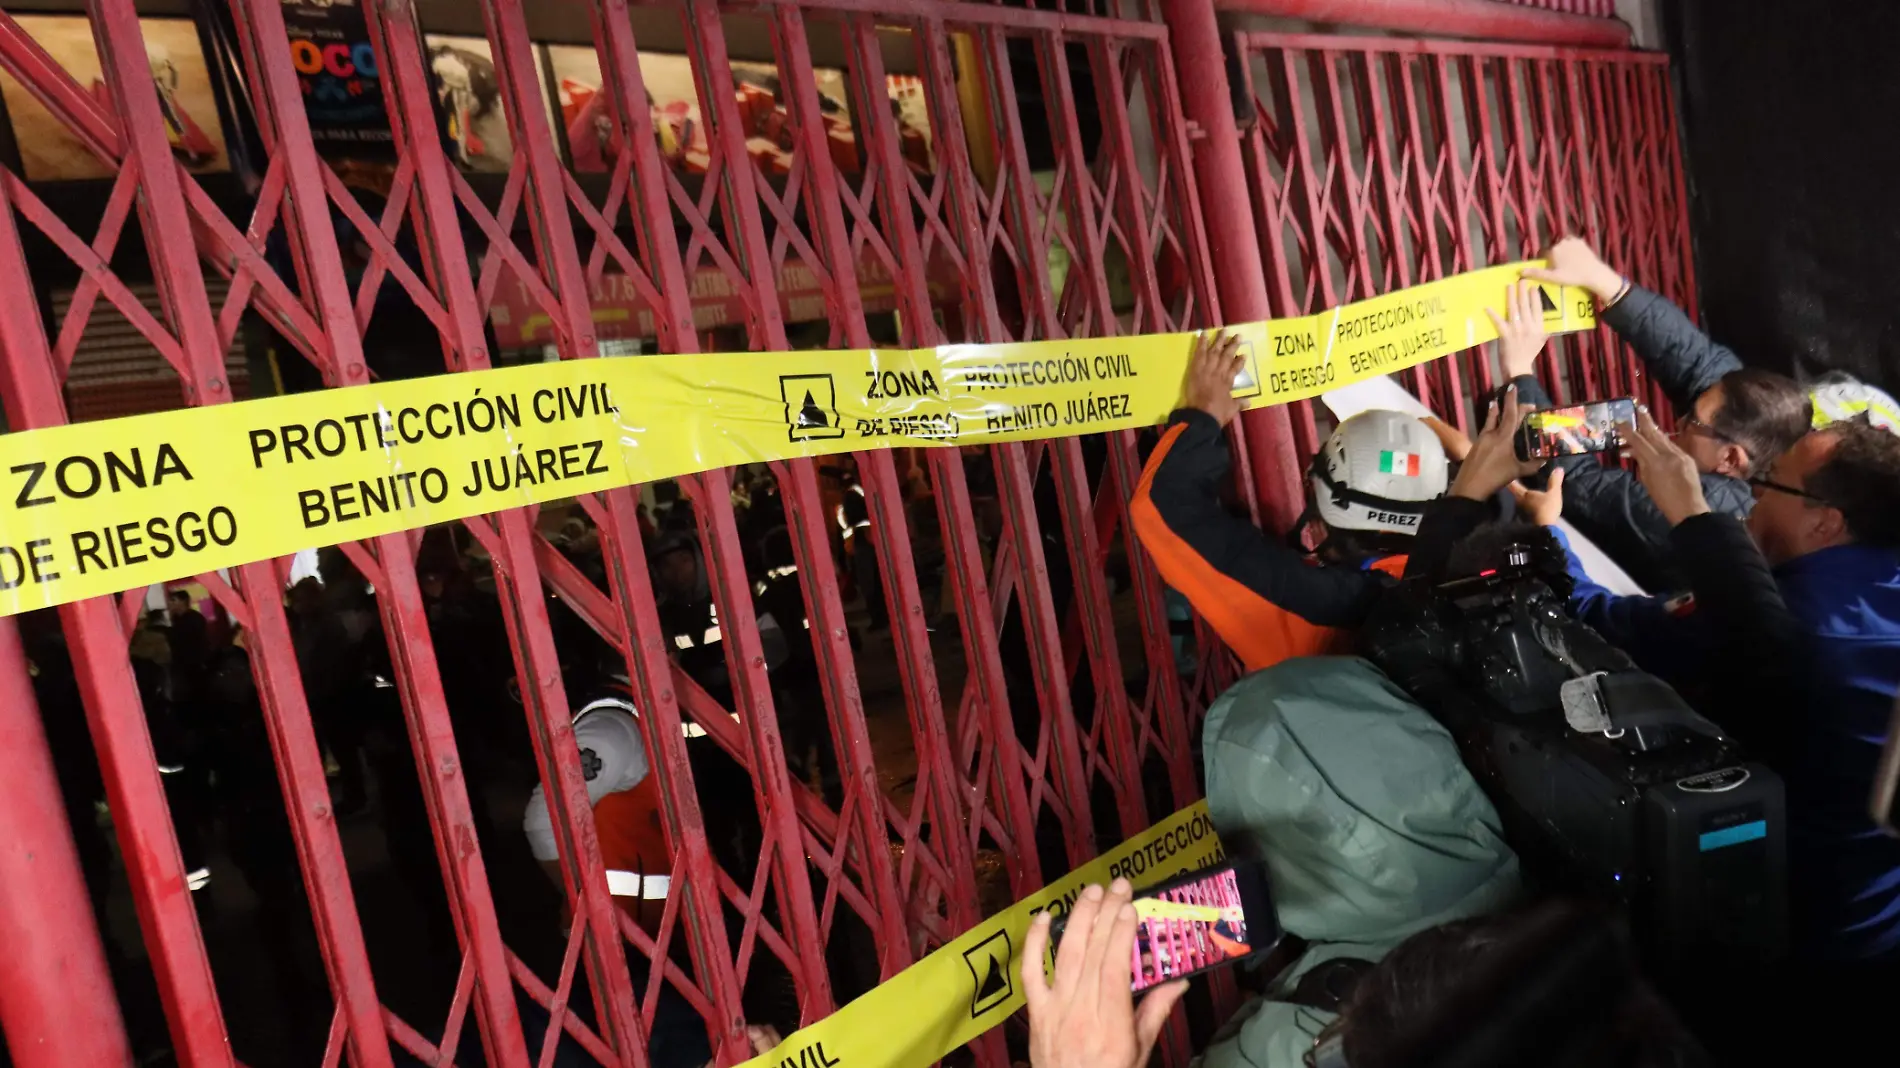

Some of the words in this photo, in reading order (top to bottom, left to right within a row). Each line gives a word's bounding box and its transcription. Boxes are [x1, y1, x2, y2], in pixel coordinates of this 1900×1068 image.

[290, 40, 378, 78] OCO
[1337, 299, 1415, 343] PROTECCIÓN
[1274, 332, 1318, 356] ZONA
[1349, 342, 1399, 374] BENITO
[1400, 328, 1447, 358] JUÁREZ
[865, 369, 940, 399] ZONA
[964, 352, 1091, 392] PROTECCIÓN
[1093, 354, 1138, 381] CIVIL
[1269, 372, 1290, 394] DE
[1290, 362, 1335, 391] RIESGO
[248, 388, 521, 469] PROTECCIÓN
[532, 382, 620, 424] CIVIL
[985, 402, 1059, 434] BENITO
[1062, 391, 1132, 426] JUÁREZ
[9, 442, 194, 509] ZONA
[298, 467, 449, 528] BENITO
[462, 440, 609, 497] JUÁREZ
[1367, 510, 1418, 527] PEREZ
[0, 537, 61, 591] DE
[71, 505, 238, 575] RIESGO
[1109, 811, 1217, 883] PROTECCIÓN
